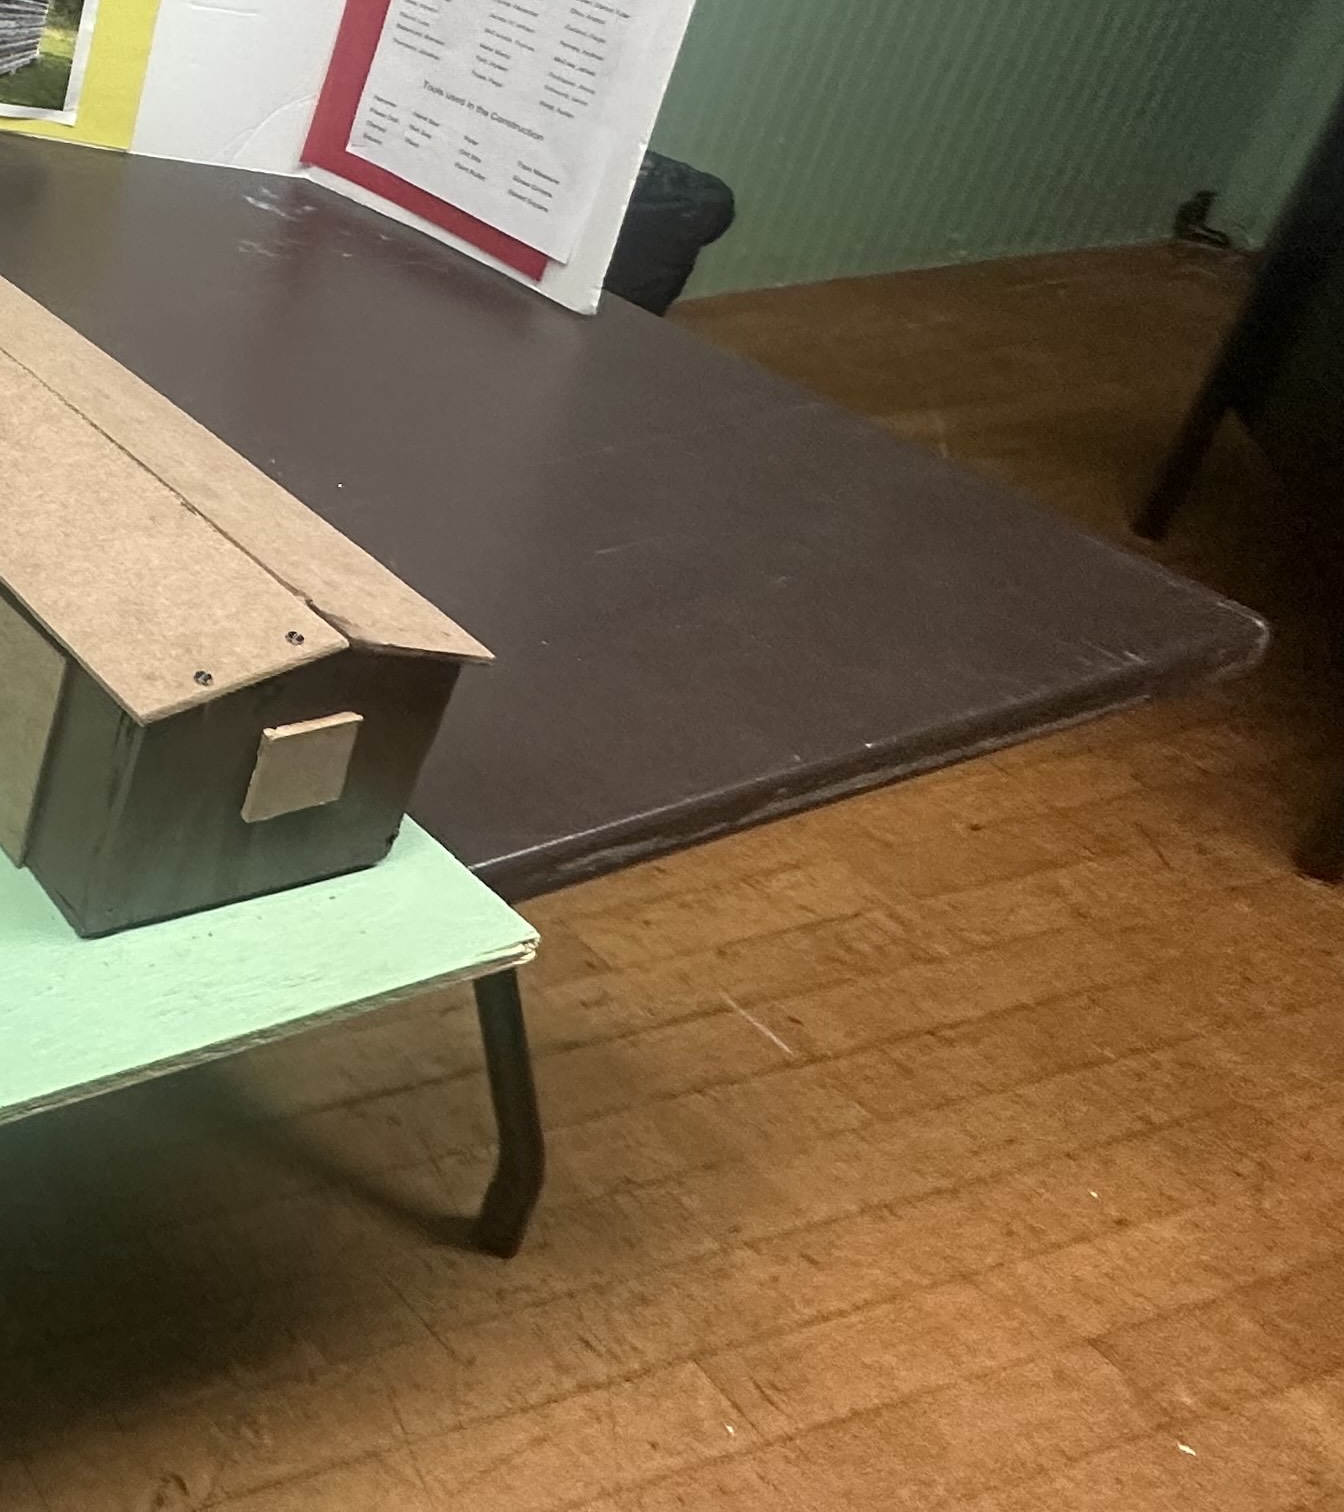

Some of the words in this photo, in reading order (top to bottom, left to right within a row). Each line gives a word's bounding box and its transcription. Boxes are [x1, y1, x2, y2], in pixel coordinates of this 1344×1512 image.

[423, 79, 445, 96] Tools
[475, 105, 489, 117] the
[490, 111, 545, 142] Construction
